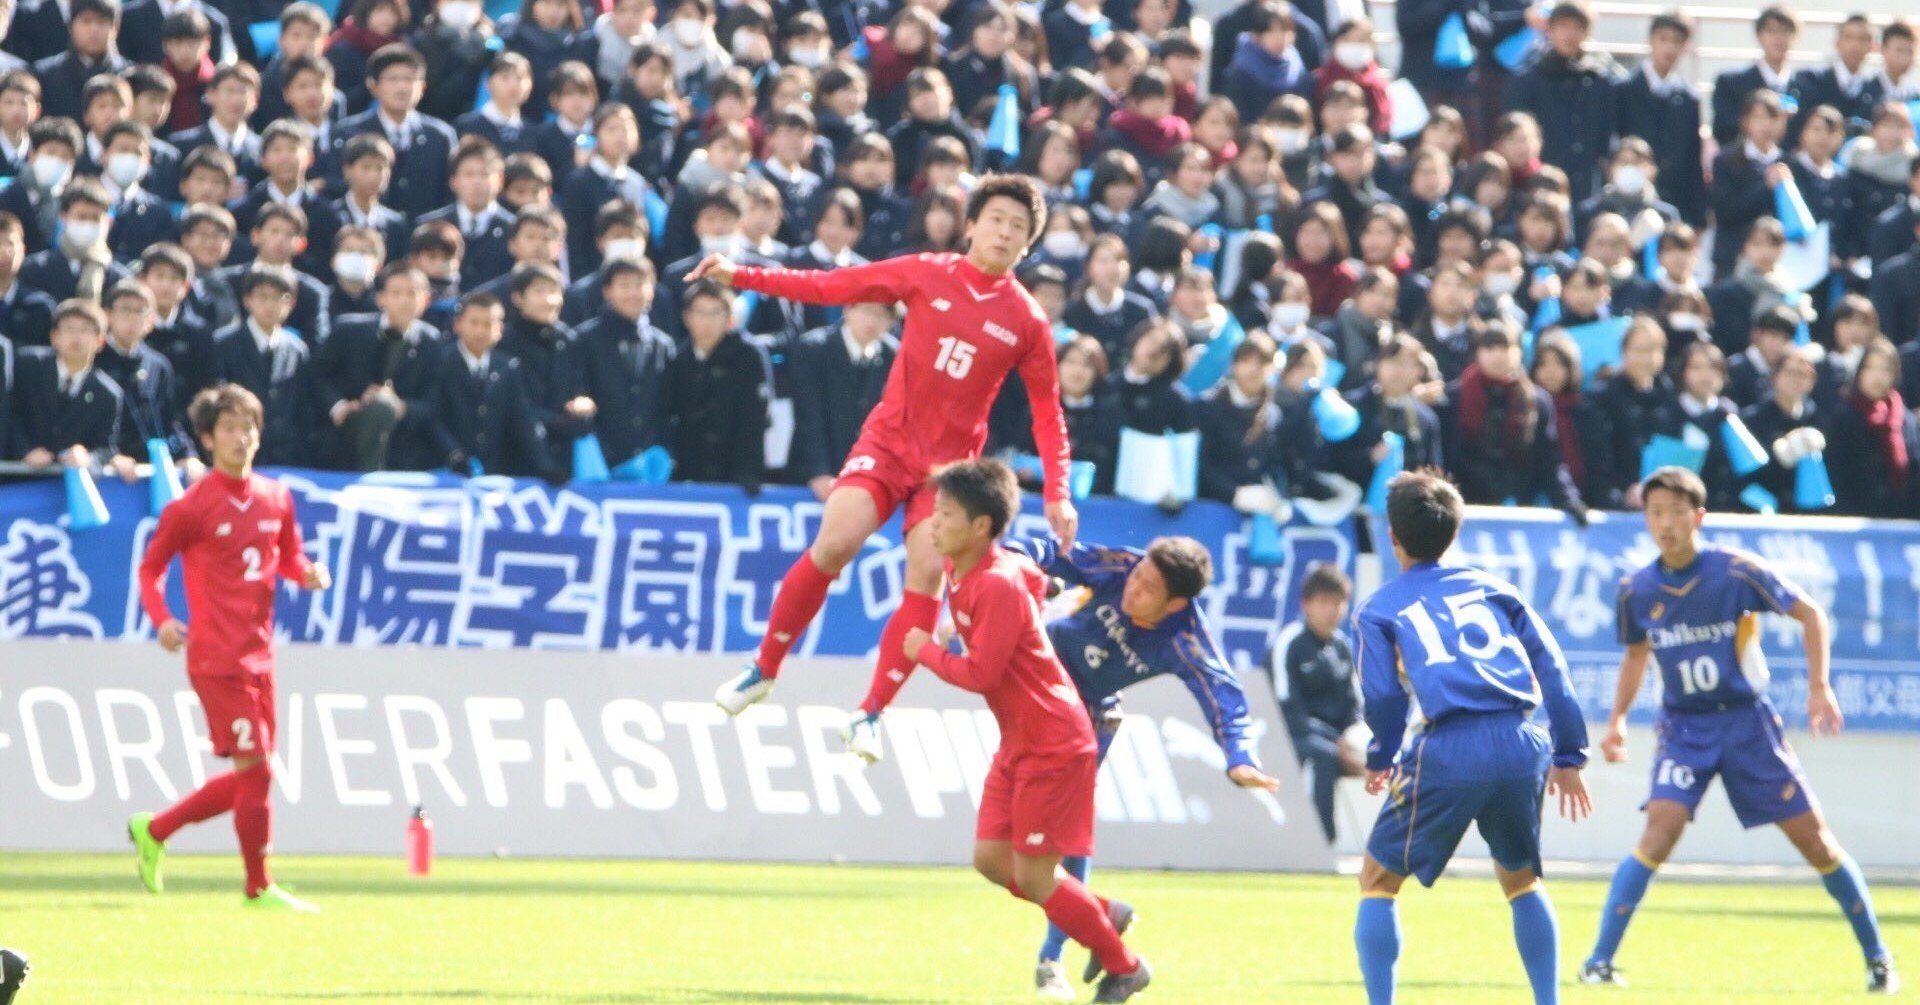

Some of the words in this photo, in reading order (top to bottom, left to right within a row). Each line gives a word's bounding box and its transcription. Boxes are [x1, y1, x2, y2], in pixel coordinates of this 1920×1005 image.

[933, 336, 977, 380] 15
[242, 547, 262, 582] 2
[1397, 588, 1502, 667] 15
[1676, 655, 1720, 695] 10
[231, 717, 256, 751] 2
[464, 697, 883, 816] FASTER
